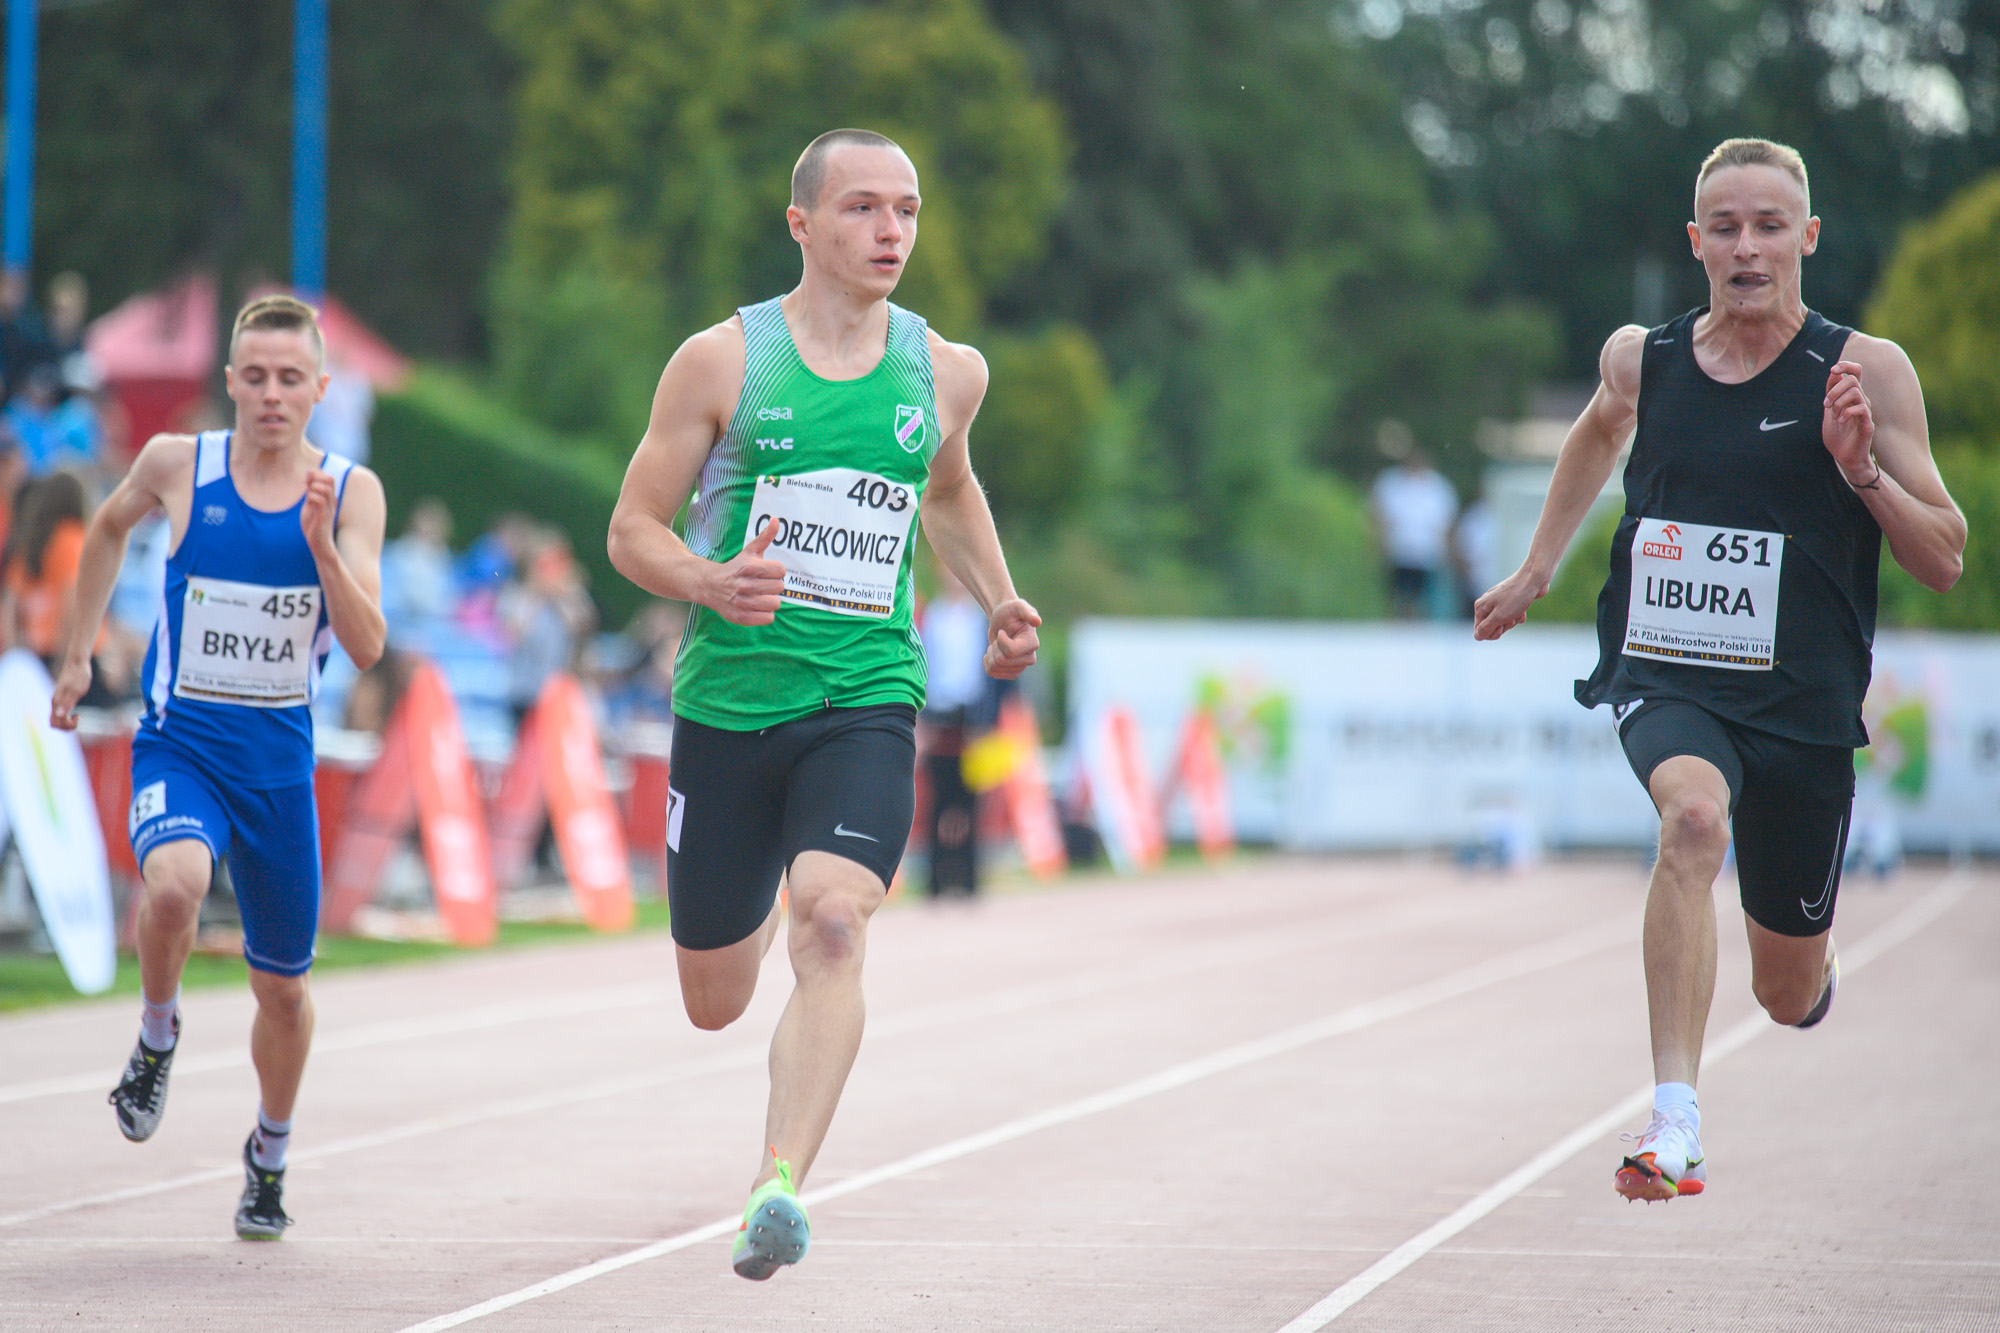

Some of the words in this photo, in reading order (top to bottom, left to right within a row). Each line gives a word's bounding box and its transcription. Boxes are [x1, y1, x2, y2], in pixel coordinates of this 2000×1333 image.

[757, 407, 793, 421] esa
[756, 438, 794, 450] TLC
[786, 478, 833, 493] Bielsko-Biała
[847, 477, 909, 513] 403
[1644, 543, 1680, 559] ORLEN
[1706, 532, 1771, 567] 651
[788, 575, 847, 595] Mistrzostwa
[849, 587, 875, 600] Polski
[877, 591, 892, 601] U18
[1645, 576, 1756, 618] LIBURA
[261, 593, 312, 619] 455
[202, 629, 294, 663] BRYŁA
[1628, 628, 1640, 639] 54.
[1641, 630, 1659, 642] PZLA
[1660, 633, 1717, 649] Mistrzostwa
[1719, 640, 1749, 652] Polski
[1752, 643, 1771, 654] U18
[1628, 643, 1684, 657] BIELSKO-BIAŁA
